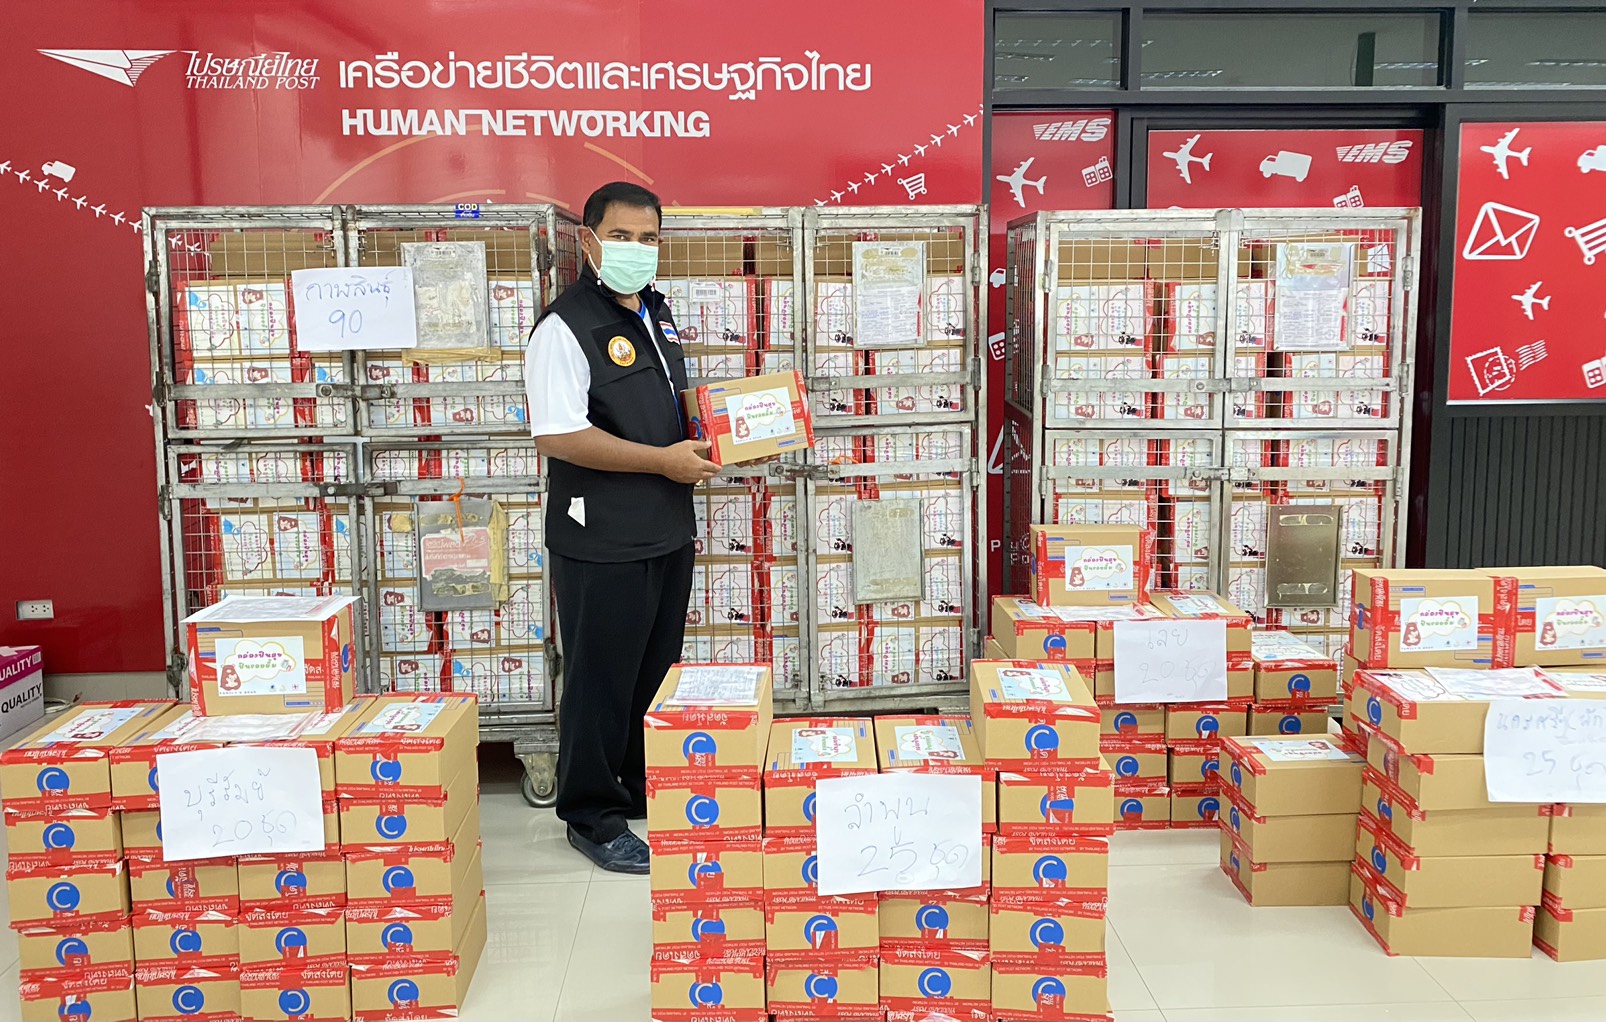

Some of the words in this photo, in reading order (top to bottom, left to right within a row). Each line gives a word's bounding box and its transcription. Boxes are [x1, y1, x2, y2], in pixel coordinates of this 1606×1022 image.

[180, 50, 319, 77] ไปรษณีย์ไทย
[339, 49, 872, 101] เครือข่ายชีวิตและเศรษฐกิจไทย
[185, 76, 269, 89] THAILAND
[275, 76, 320, 90] POST
[341, 109, 467, 136] HUMAN
[481, 109, 710, 138] NETWORKING
[1038, 118, 1111, 141] EMS
[1340, 140, 1413, 163] EMS
[458, 203, 478, 211] COD
[328, 309, 363, 338] 90
[238, 650, 283, 661] กล่องปันสุข
[1, 683, 42, 714] QUALITY
[682, 712, 729, 726] จัดส่งโดย
[1522, 750, 1557, 776] 25
[212, 819, 254, 847] 20
[1029, 836, 1076, 847] จัดส่งโดย
[857, 842, 918, 877] 25
[895, 948, 941, 960] จัดส่งโดย
[300, 969, 344, 979] จัดส่งโดย
